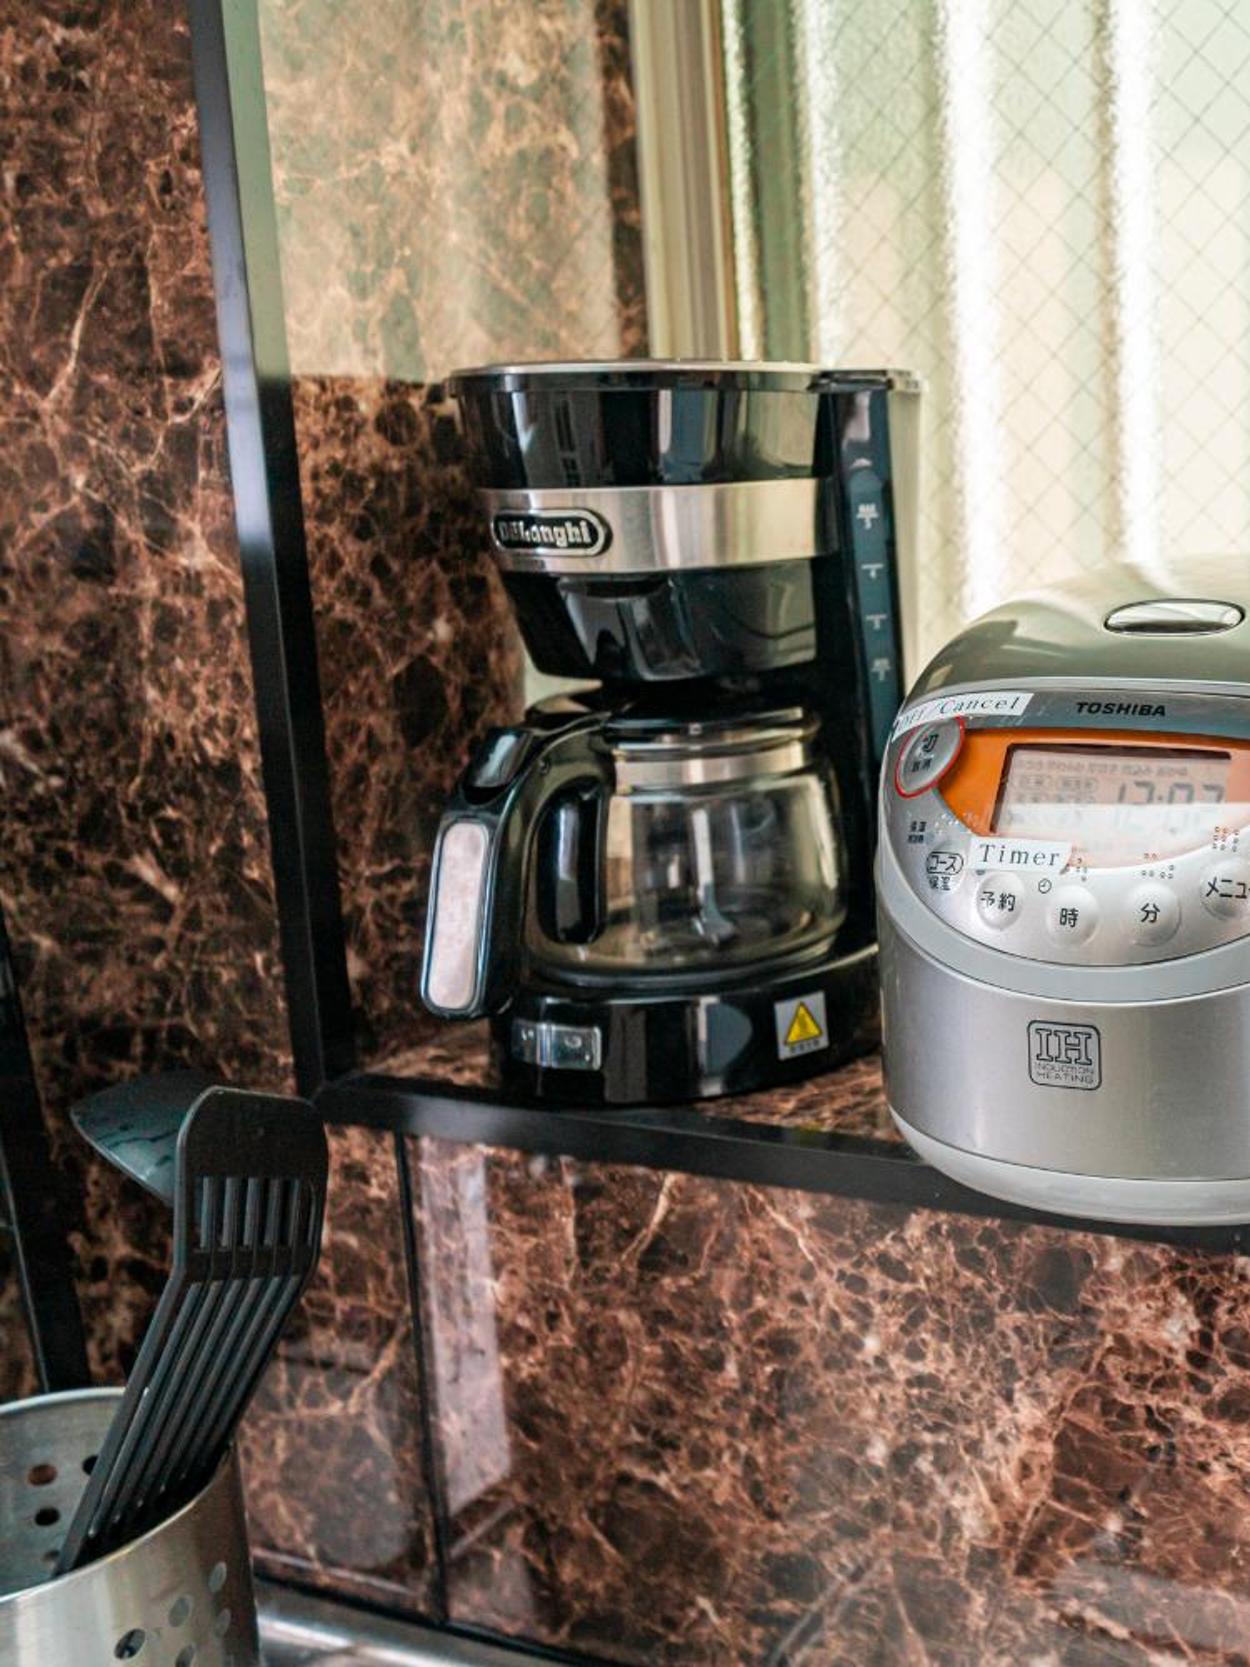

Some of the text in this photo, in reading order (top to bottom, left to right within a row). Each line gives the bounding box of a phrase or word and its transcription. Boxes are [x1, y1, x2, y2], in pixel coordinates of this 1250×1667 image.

[1076, 702, 1166, 717] TOSHIBA
[928, 854, 957, 872] コース
[979, 844, 1060, 866] Timer
[980, 890, 1016, 913] 予約
[1059, 908, 1079, 928] 時
[1140, 903, 1161, 923] 分
[1035, 1028, 1093, 1066] IH
